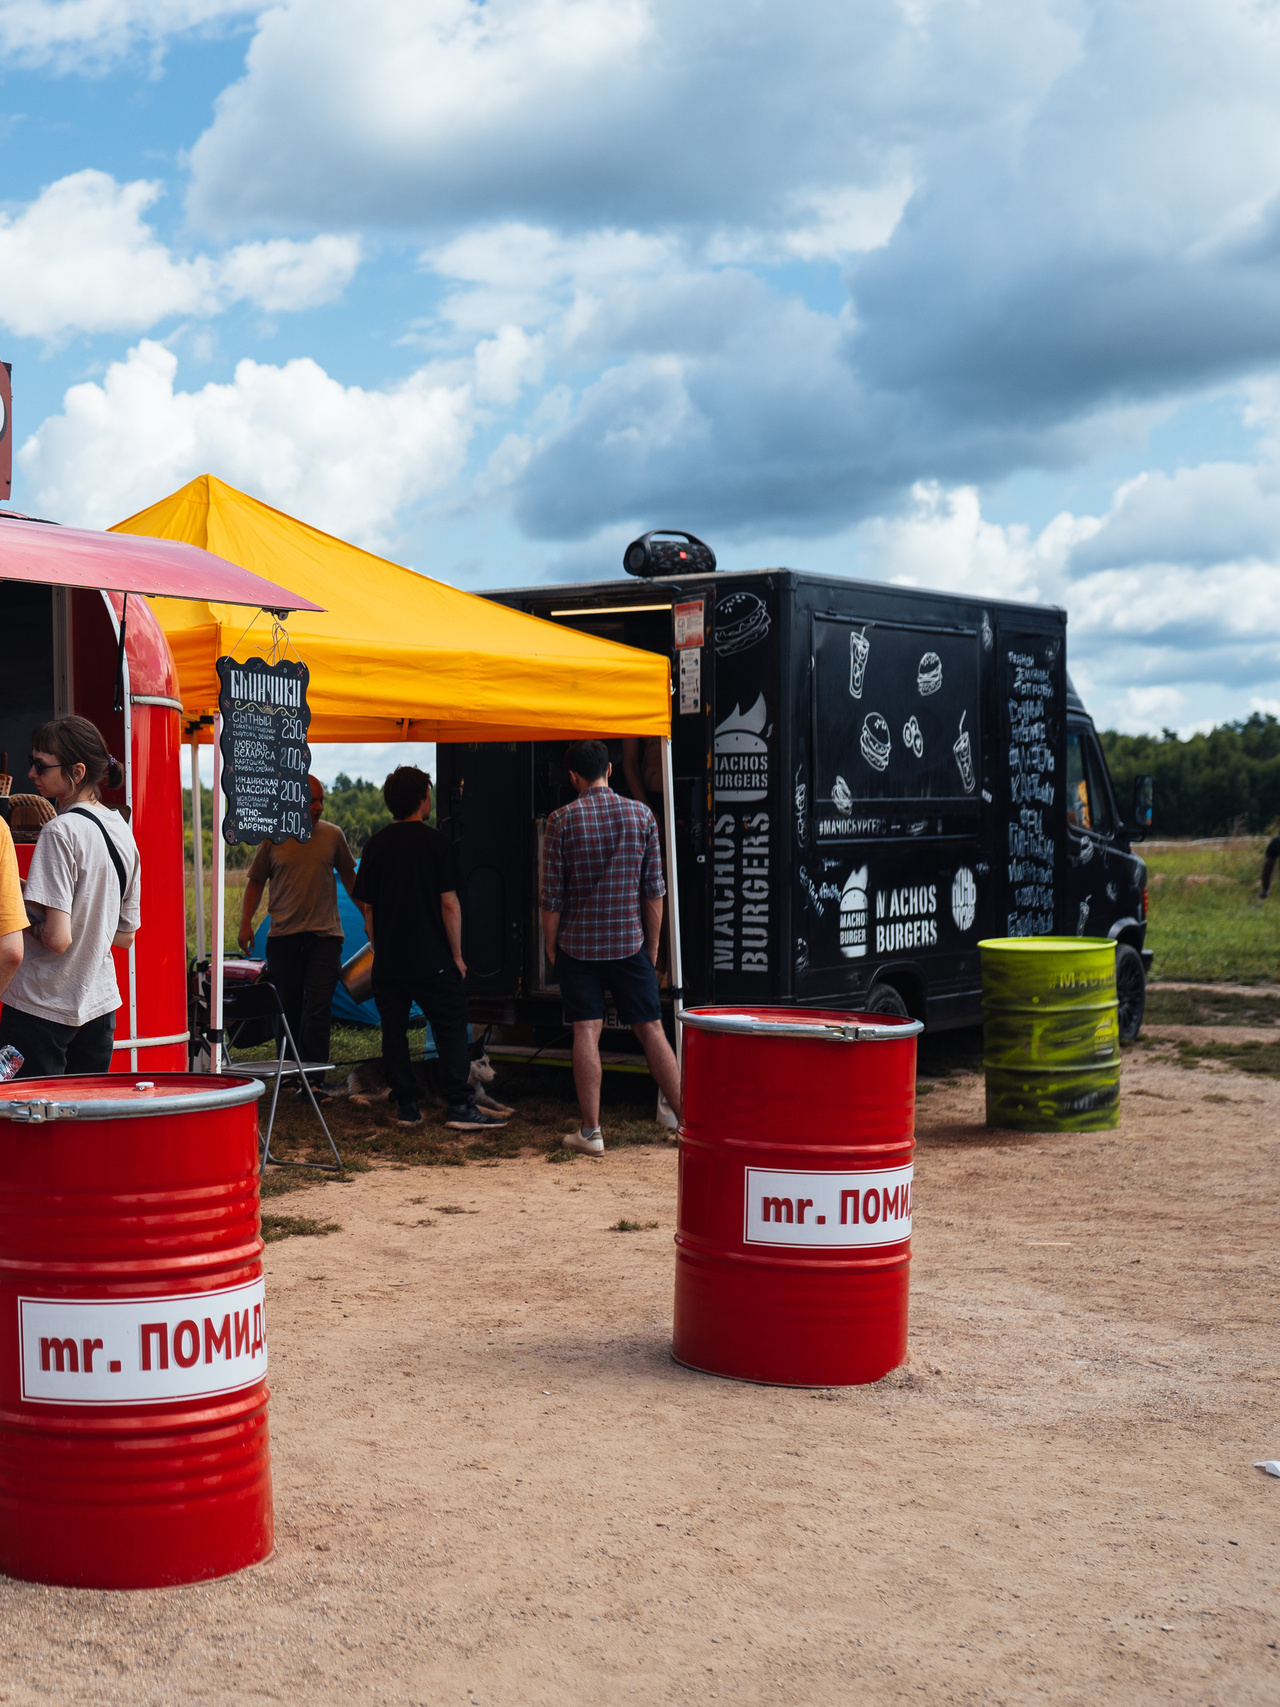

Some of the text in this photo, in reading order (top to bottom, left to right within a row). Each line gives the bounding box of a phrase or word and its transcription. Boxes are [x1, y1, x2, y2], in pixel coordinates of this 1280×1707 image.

[231, 670, 301, 708] БЛИНЧИКИ
[232, 711, 307, 744] СЫТНЫЙ 250р.
[234, 740, 268, 752] ЛЮБОВЬ
[280, 747, 307, 775] 200р.
[235, 776, 279, 788] ИНДИЙСКАЯ
[235, 780, 307, 808] КЛАССИКА 200р.
[715, 773, 768, 788] URGERS
[236, 807, 261, 817] МЯТНО-
[280, 811, 306, 839] 150р.
[741, 812, 770, 972] BURGERS
[876, 919, 938, 953] BURGERS
[763, 1196, 826, 1225] mr.
[40, 1336, 121, 1373] mr.
